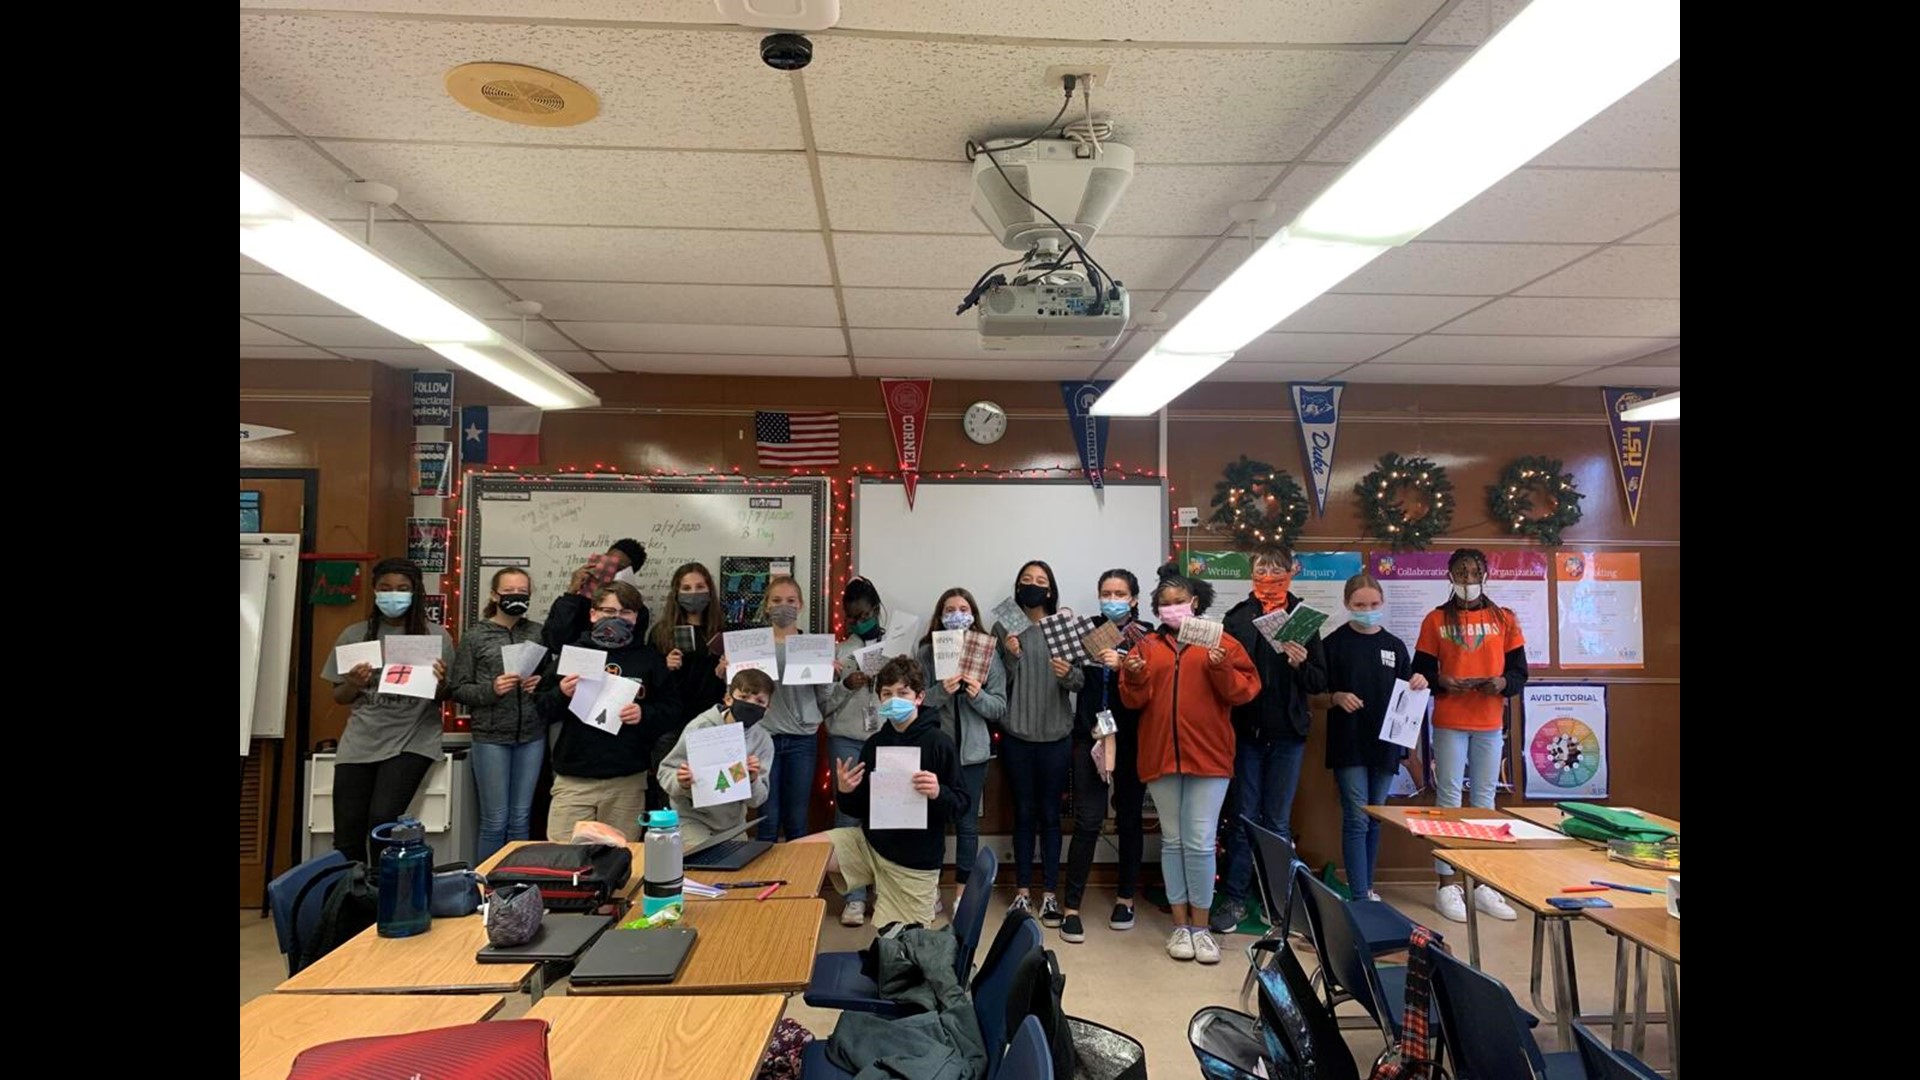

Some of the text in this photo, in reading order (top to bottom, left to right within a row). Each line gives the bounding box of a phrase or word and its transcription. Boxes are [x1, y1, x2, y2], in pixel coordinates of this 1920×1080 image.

[414, 382, 449, 393] FOLLOW
[1627, 426, 1642, 466] LSU
[1311, 431, 1330, 475] Duke
[1207, 567, 1241, 578] Writing
[1303, 567, 1337, 578] Inquiry
[1529, 694, 1598, 702] AVID TUTORIAL
